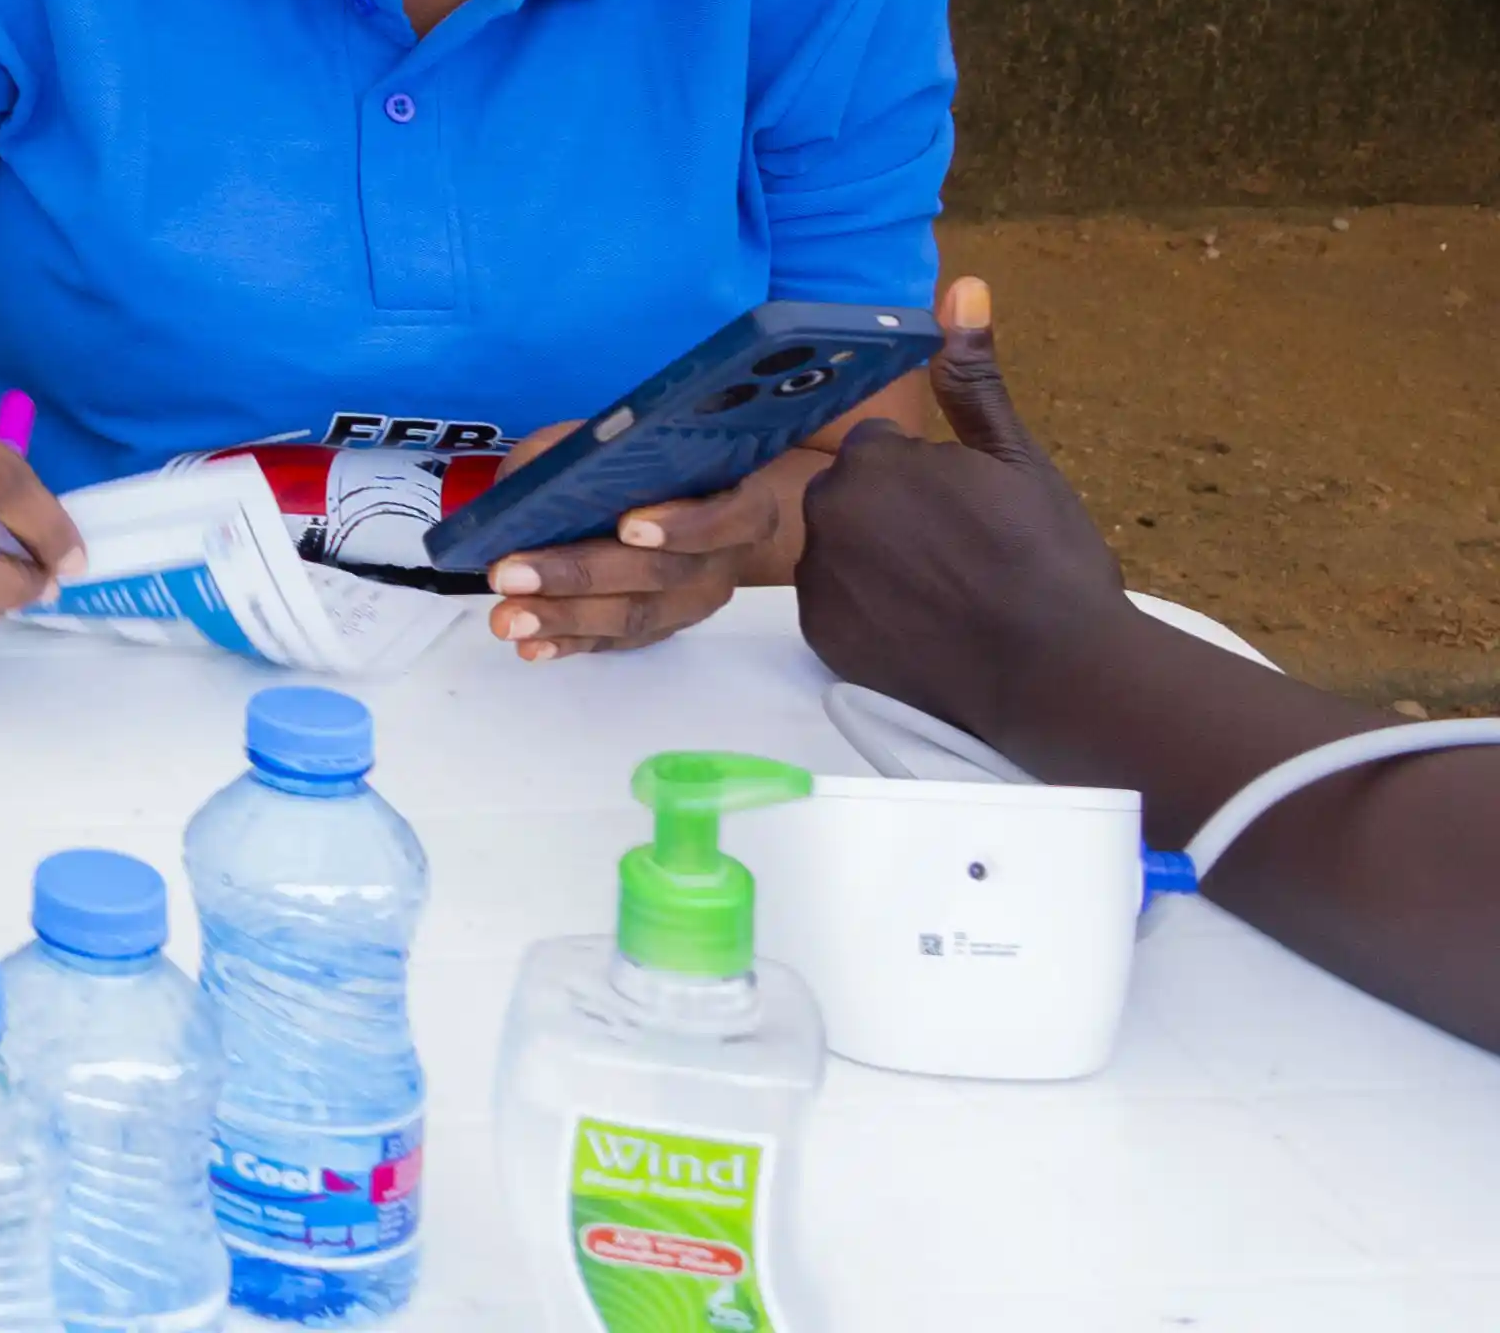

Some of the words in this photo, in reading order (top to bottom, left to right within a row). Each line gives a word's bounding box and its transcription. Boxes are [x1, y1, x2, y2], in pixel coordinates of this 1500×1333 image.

[321, 411, 502, 450] FFB
[232, 1150, 321, 1194] Cool
[584, 1129, 746, 1189] Wind
